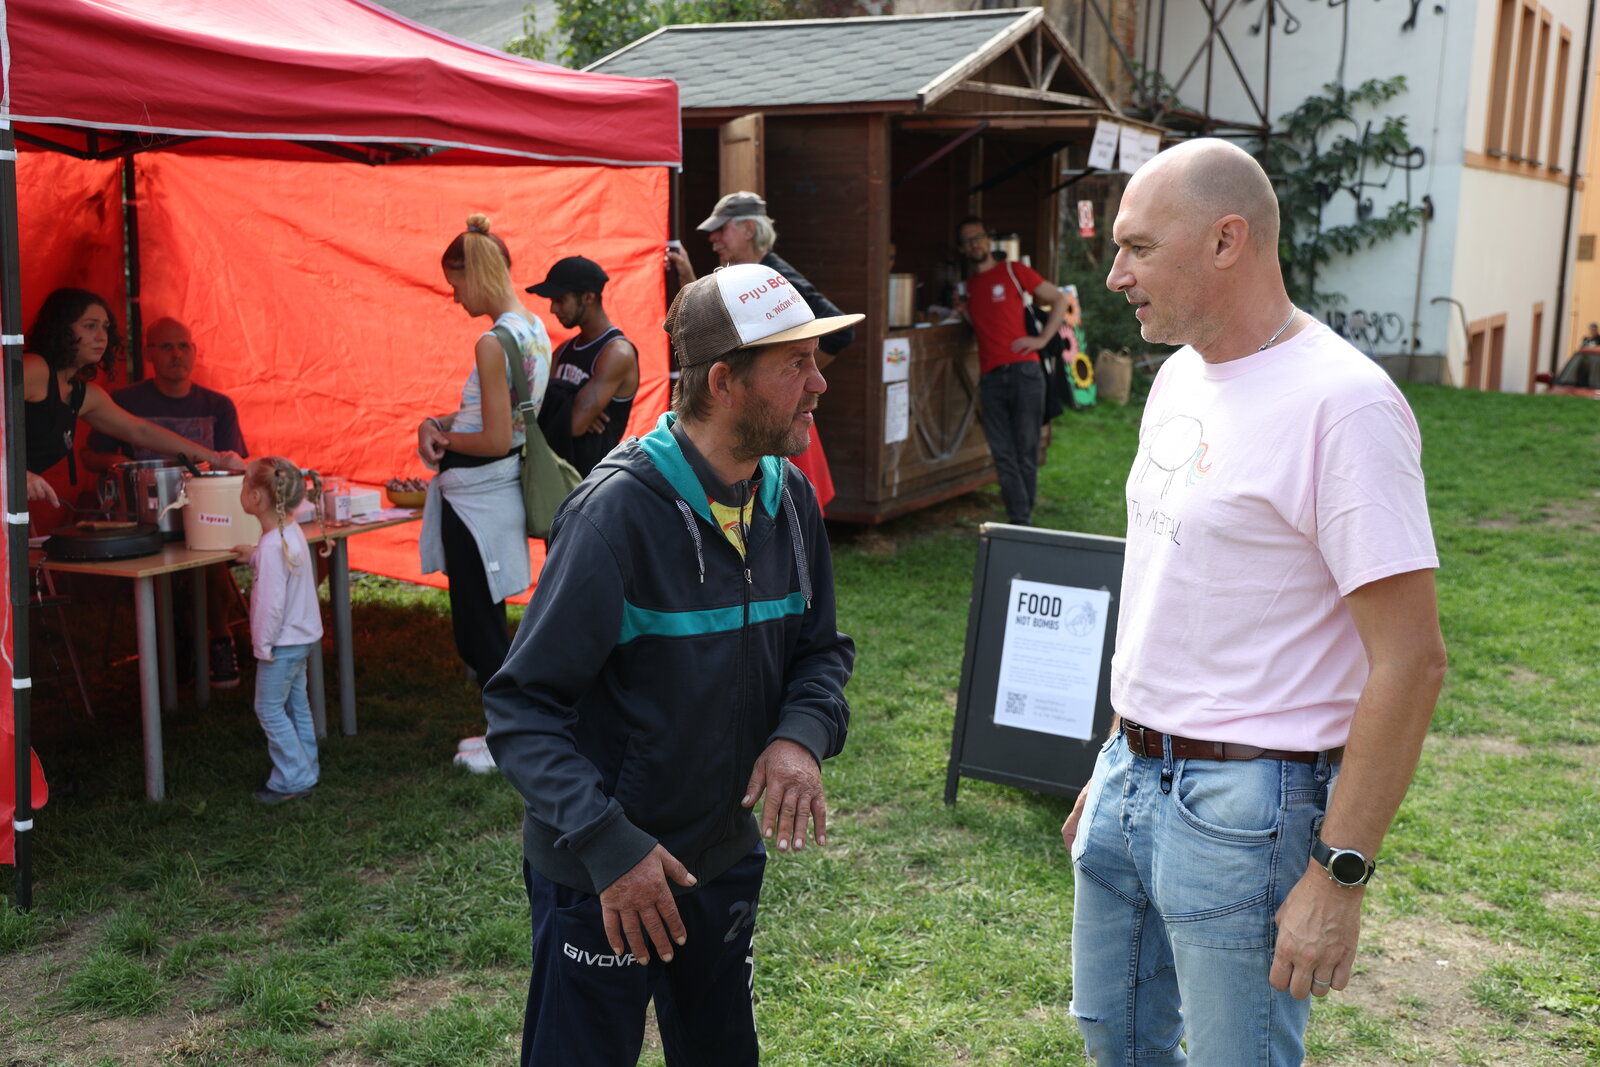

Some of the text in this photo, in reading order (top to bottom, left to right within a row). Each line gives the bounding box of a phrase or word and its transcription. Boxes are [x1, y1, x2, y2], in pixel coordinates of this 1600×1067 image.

[739, 285, 768, 304] PIJU
[1017, 592, 1062, 618] FOOD
[1016, 615, 1060, 631] NOT BOMBS
